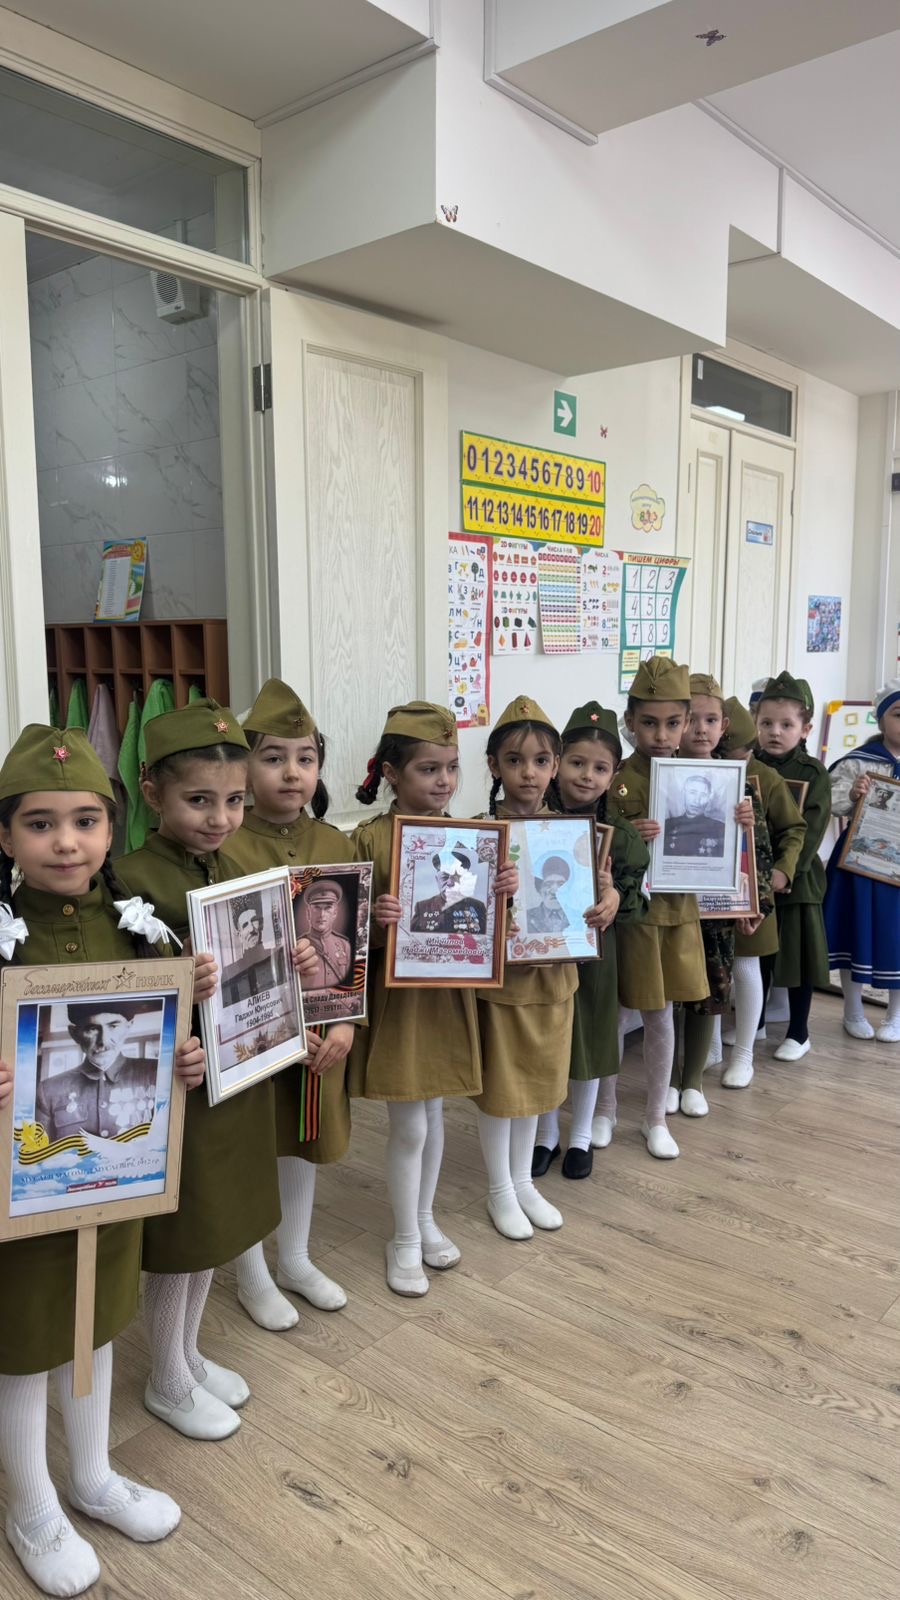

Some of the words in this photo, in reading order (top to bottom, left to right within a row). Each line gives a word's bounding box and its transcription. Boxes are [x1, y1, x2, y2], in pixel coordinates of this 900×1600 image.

[468, 445, 476, 471] 0
[482, 448, 489, 473] 1
[494, 450, 503, 475] 2
[507, 453, 516, 478] 3
[519, 456, 527, 480] 4
[531, 458, 539, 482] 5
[542, 461, 550, 484] 6
[554, 463, 562, 486] 7
[565, 465, 573, 488] 8
[577, 468, 584, 490] 9
[588, 471, 601, 493] 10
[468, 496, 478, 521] 11
[482, 498, 494, 522] 12
[497, 501, 508, 524] 13
[511, 502, 523, 526] 14
[525, 505, 536, 528] 15
[538, 507, 549, 530] 16
[552, 509, 562, 532] 17
[565, 512, 575, 533] 18
[577, 514, 588, 535] 19
[590, 516, 601, 536] 20
[628, 554, 652, 564] ПИШЕМ
[654, 558, 680, 566] ЦИФРЫ
[632, 569, 639, 588] 1
[647, 570, 656, 589] 2
[665, 571, 676, 590] 3
[632, 596, 638, 616] 4
[646, 596, 653, 616] 5
[662, 597, 670, 616] 6
[632, 624, 638, 643] 7
[648, 624, 654, 643] 8
[662, 624, 668, 642] 9
[248, 991, 270, 1008] АЛИЕВ
[235, 1010, 253, 1023] Гаджи
